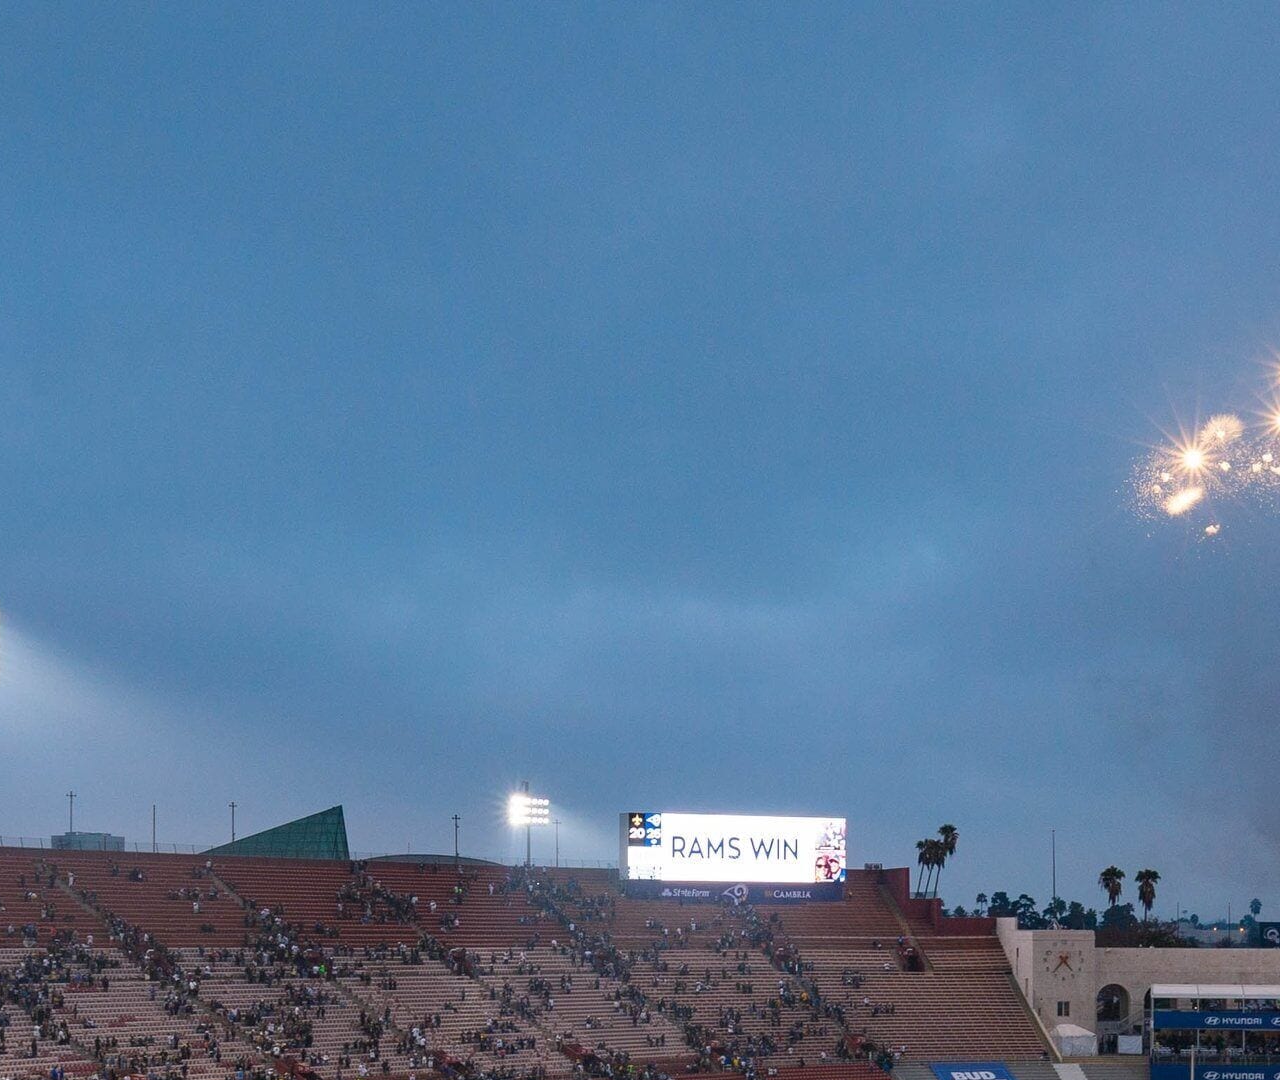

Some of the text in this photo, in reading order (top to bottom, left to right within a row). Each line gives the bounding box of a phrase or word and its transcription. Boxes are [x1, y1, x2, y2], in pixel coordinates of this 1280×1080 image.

[629, 827, 645, 839] 20
[672, 836, 798, 860] RAMS WIN
[773, 890, 811, 898] CAMBRIA
[950, 1071, 996, 1080] BUD
